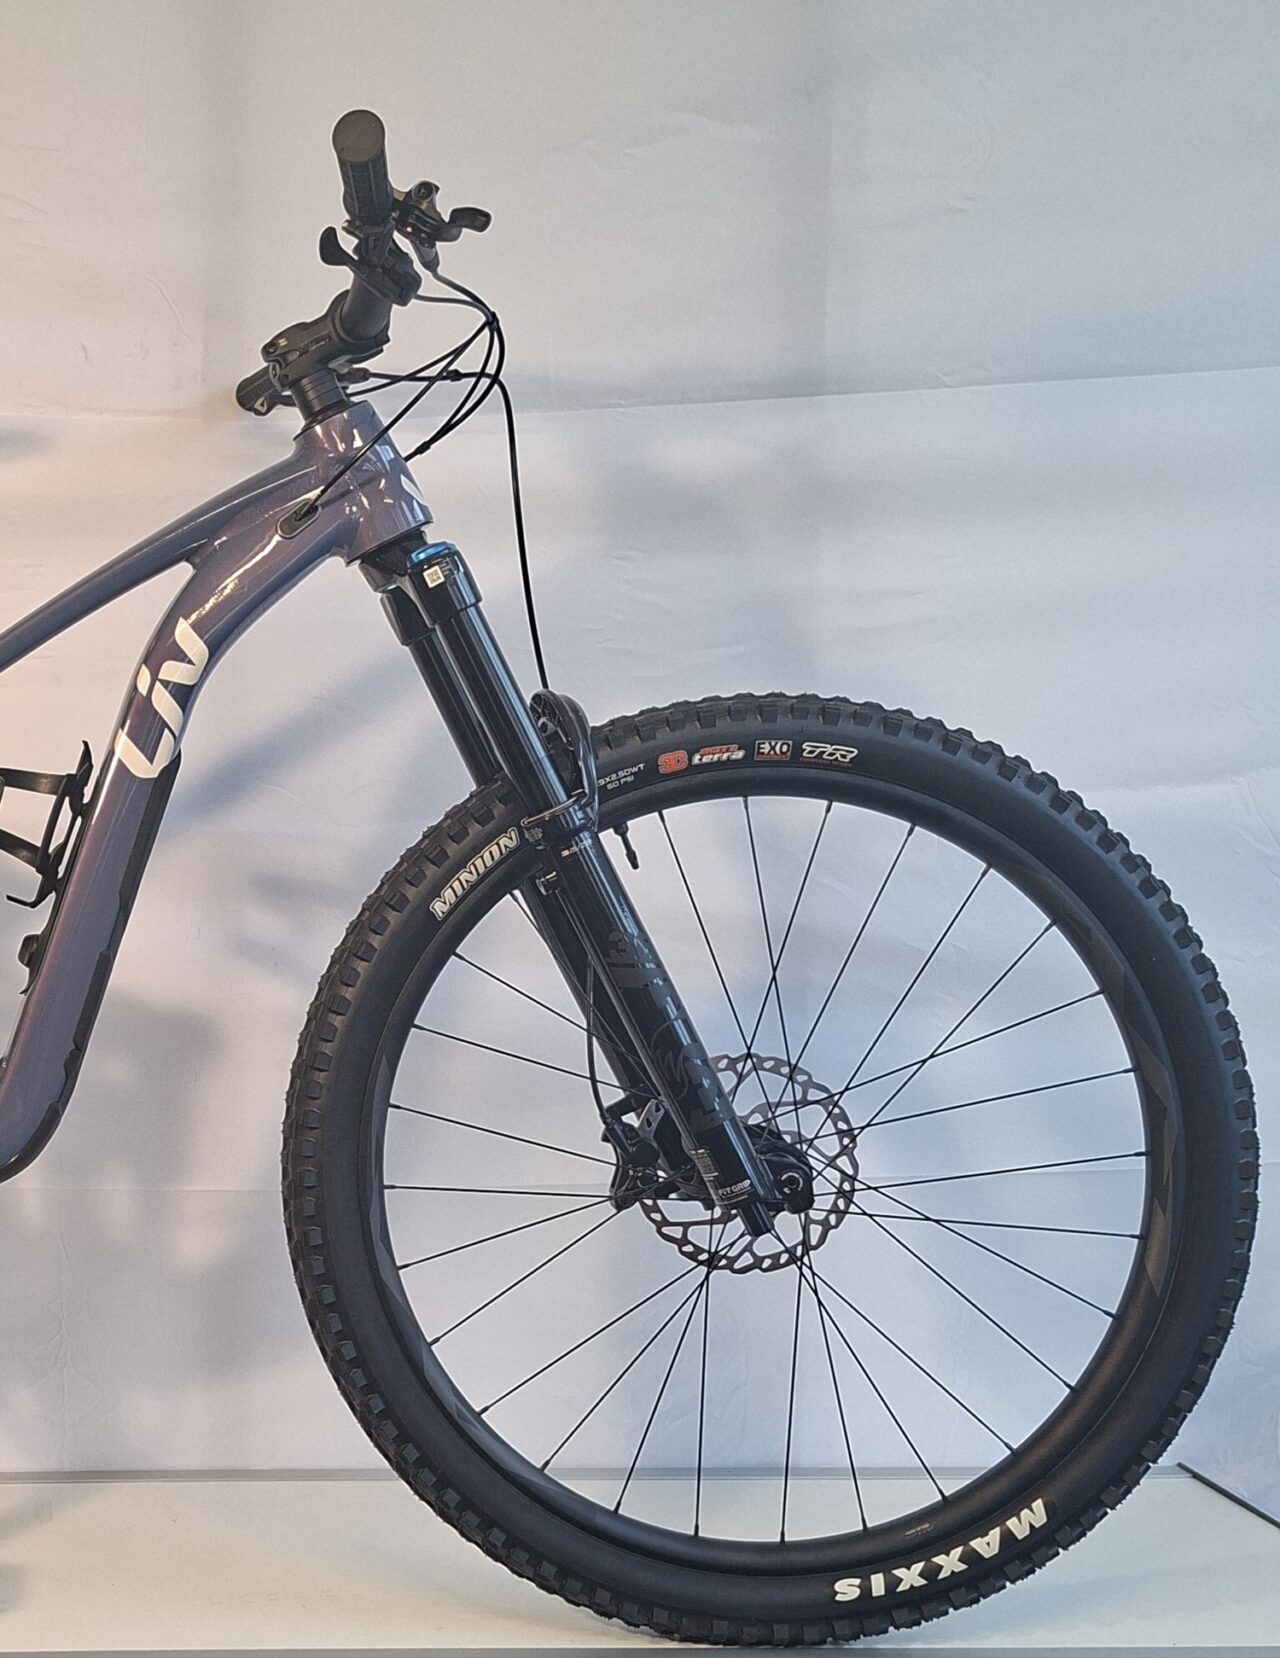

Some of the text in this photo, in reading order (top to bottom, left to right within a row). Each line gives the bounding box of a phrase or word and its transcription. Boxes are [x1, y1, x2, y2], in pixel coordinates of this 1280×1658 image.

[691, 749, 746, 766] terra
[756, 740, 792, 756] EXO
[801, 741, 859, 763] TR
[596, 763, 645, 787] 9X2.50WT
[429, 827, 520, 921] MINION
[834, 1497, 1048, 1602] MAXXIS
